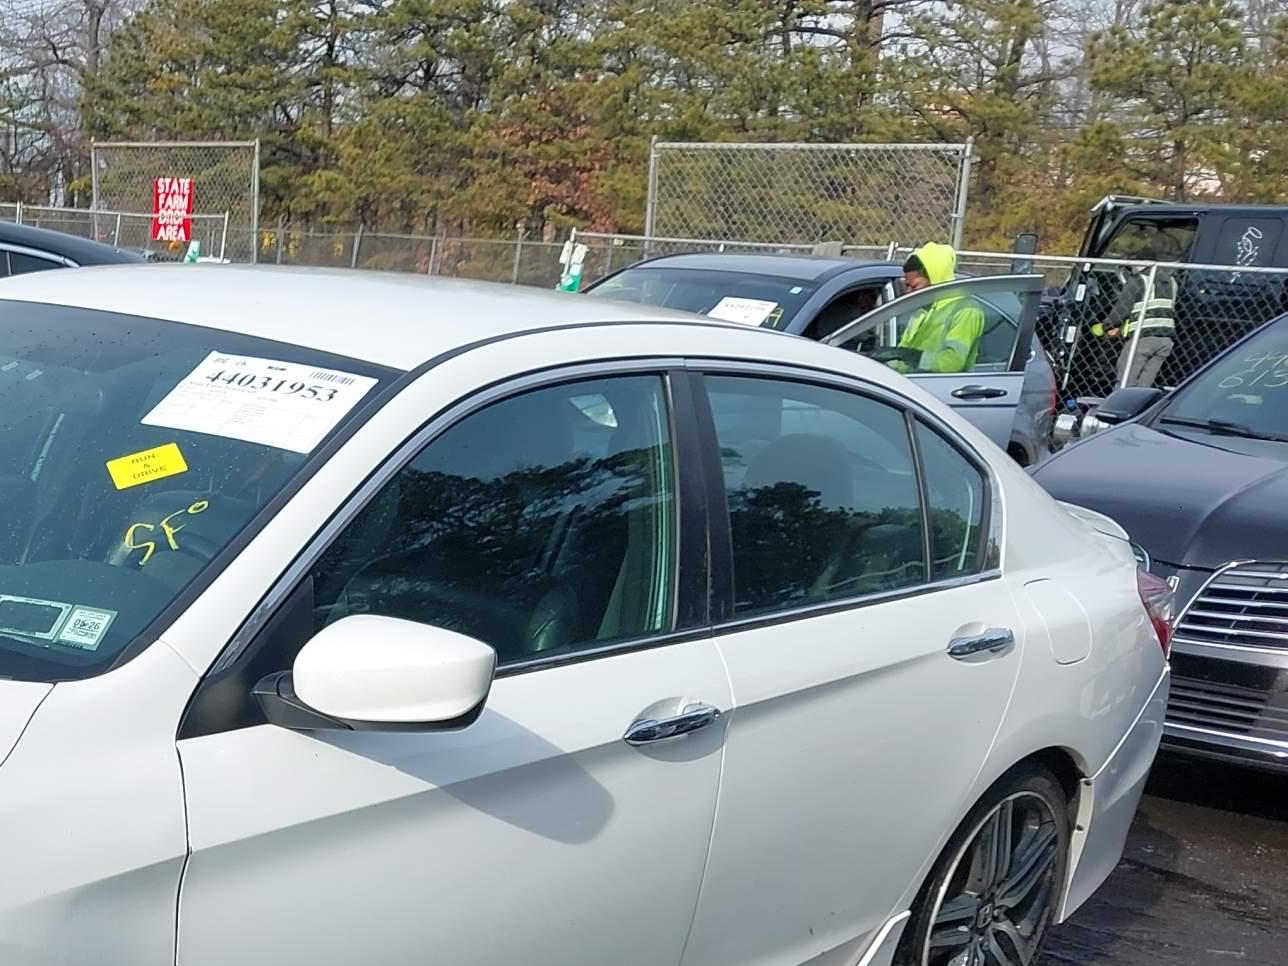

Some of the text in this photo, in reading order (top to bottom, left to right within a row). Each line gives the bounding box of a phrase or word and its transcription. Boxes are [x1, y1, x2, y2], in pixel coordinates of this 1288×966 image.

[158, 177, 191, 194] STATE
[158, 193, 189, 210] FARM
[158, 209, 187, 225] DROP
[156, 224, 186, 241] AREA
[205, 369, 339, 402] 44031953
[131, 453, 156, 464] RUN
[133, 465, 167, 479] DRIVE
